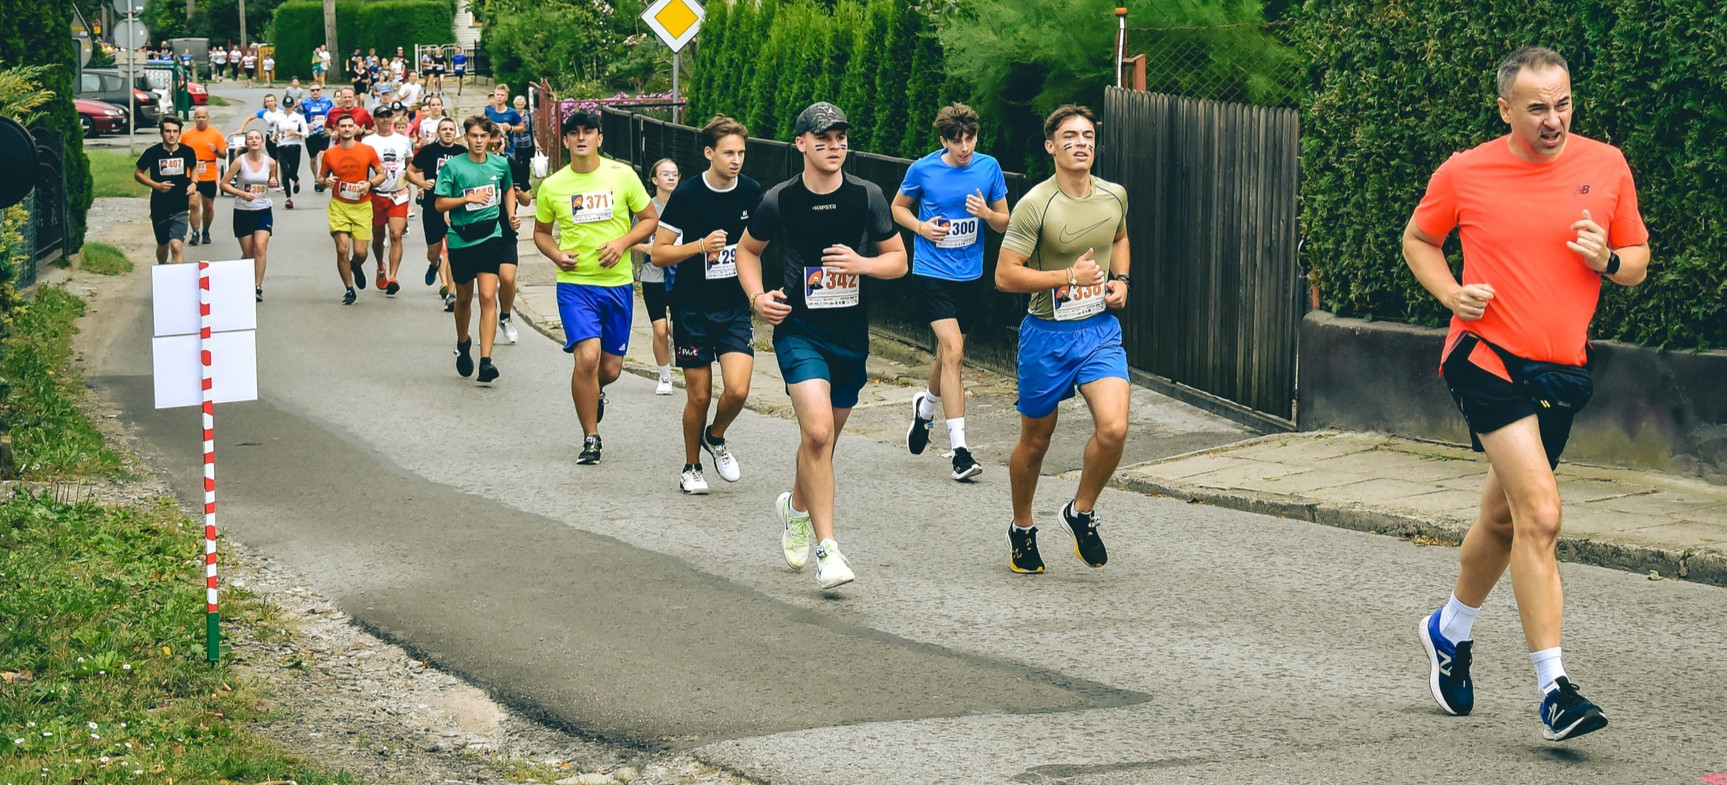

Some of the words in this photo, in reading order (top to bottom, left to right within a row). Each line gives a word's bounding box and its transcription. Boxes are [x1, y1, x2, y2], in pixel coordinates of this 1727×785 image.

[586, 194, 609, 210] 371
[952, 220, 975, 236] 300
[722, 248, 736, 265] 29
[826, 268, 857, 290] 342
